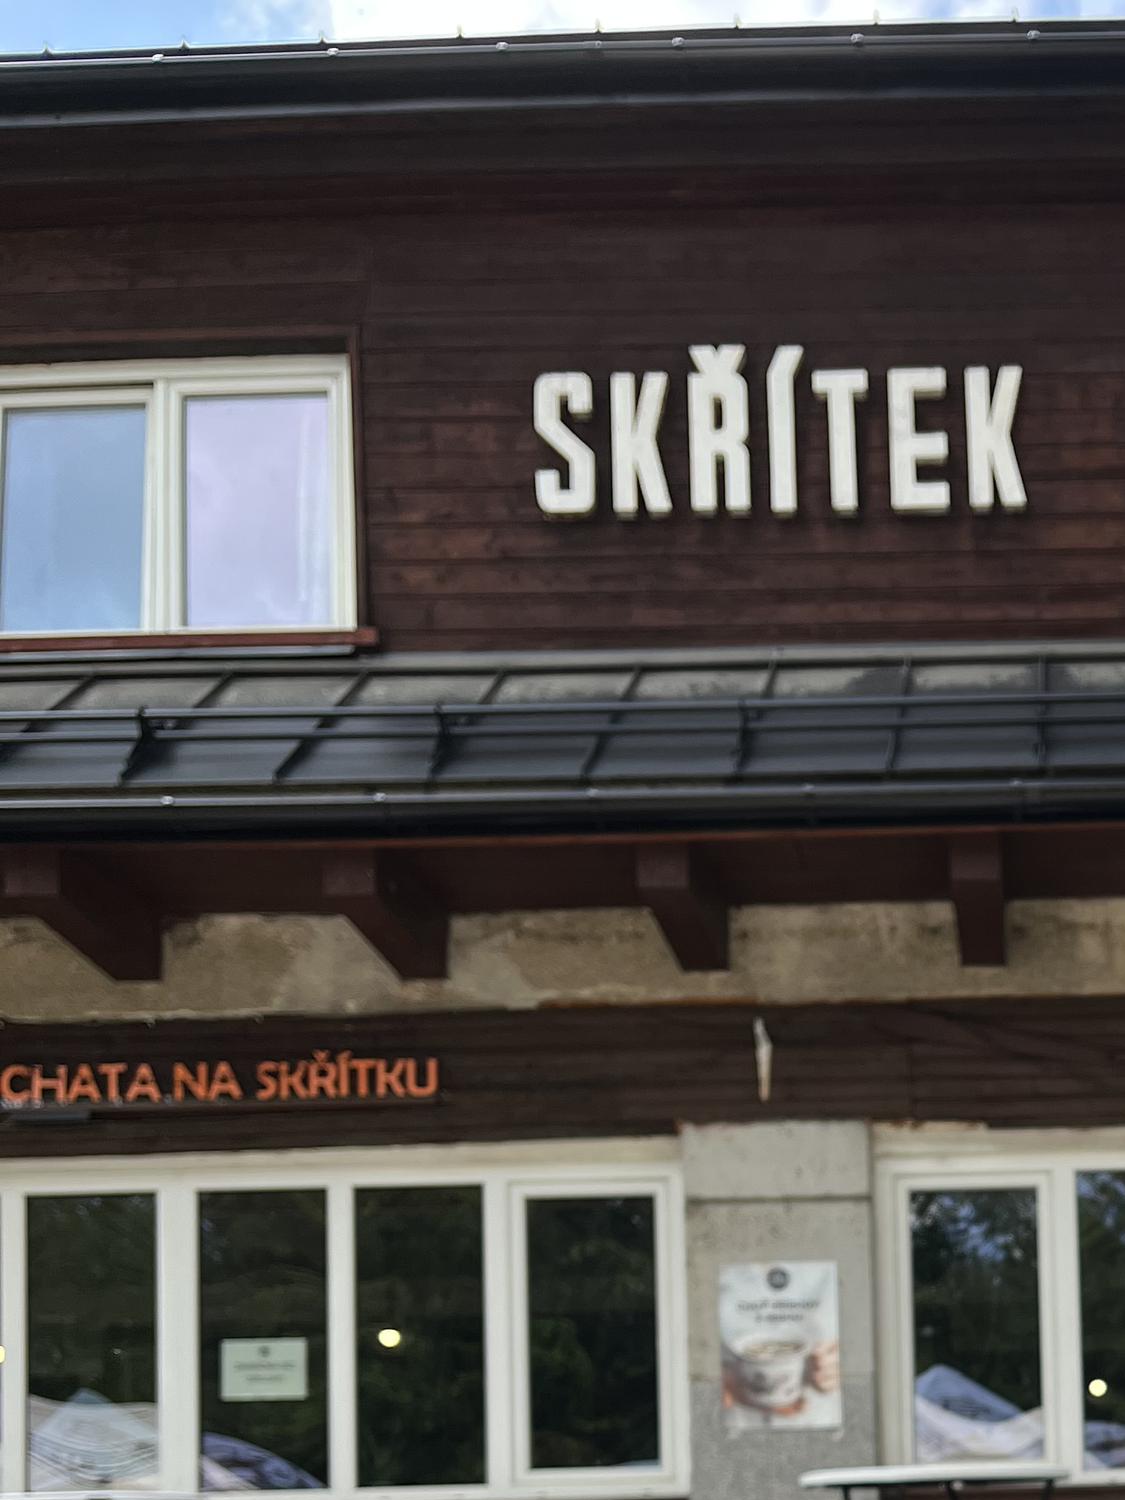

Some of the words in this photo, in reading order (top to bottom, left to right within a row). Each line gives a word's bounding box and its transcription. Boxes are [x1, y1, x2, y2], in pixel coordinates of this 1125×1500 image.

[533, 344, 1028, 517] SKŘÍTEK
[0, 1062, 161, 1104] CHATA
[171, 1060, 243, 1102] NA
[255, 1048, 440, 1100] SKŘÍTKU
